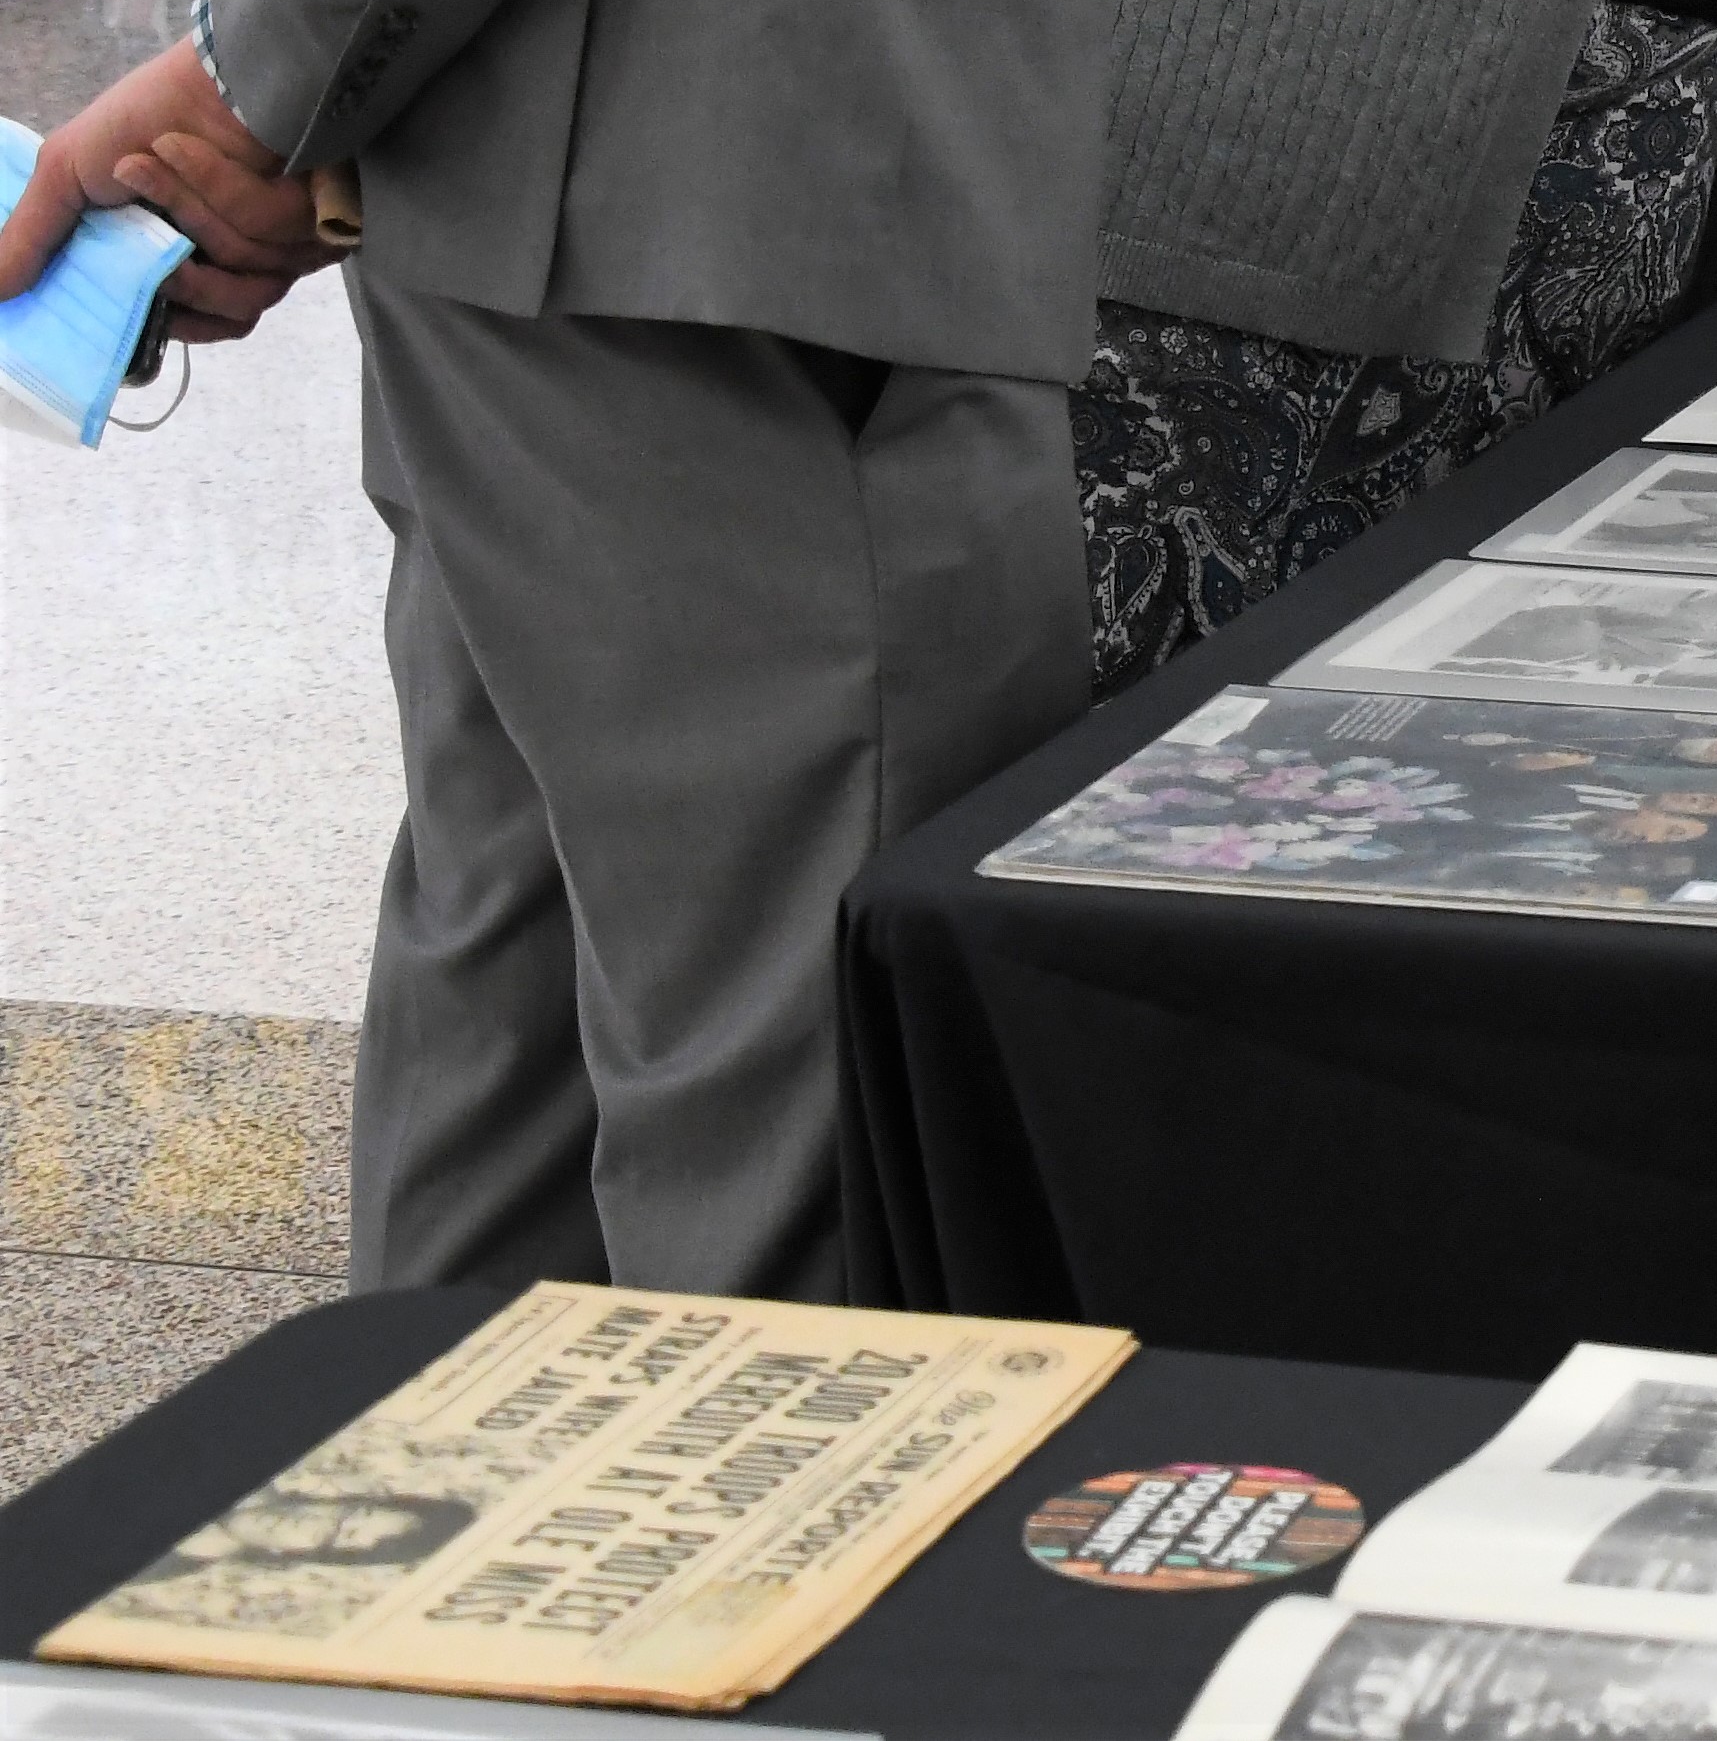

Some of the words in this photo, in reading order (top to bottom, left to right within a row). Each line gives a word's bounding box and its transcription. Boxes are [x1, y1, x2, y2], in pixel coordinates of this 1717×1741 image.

[557, 1306, 669, 1360] MATE
[602, 1313, 736, 1387] STRAPS
[467, 1366, 589, 1431] JAILED
[631, 1351, 830, 1458] MEREDITH
[780, 1349, 930, 1423] 20,000
[580, 1466, 687, 1498] AT
[660, 1432, 839, 1519] TROOPS
[1147, 1471, 1234, 1535] TOUCH
[511, 1507, 637, 1551] OLE
[739, 1432, 958, 1585] SUN-REPORTE
[1180, 1496, 1257, 1555] DON'T
[523, 1527, 721, 1636] PROTECT
[1109, 1537, 1172, 1575] THE
[418, 1560, 569, 1625] MISS
